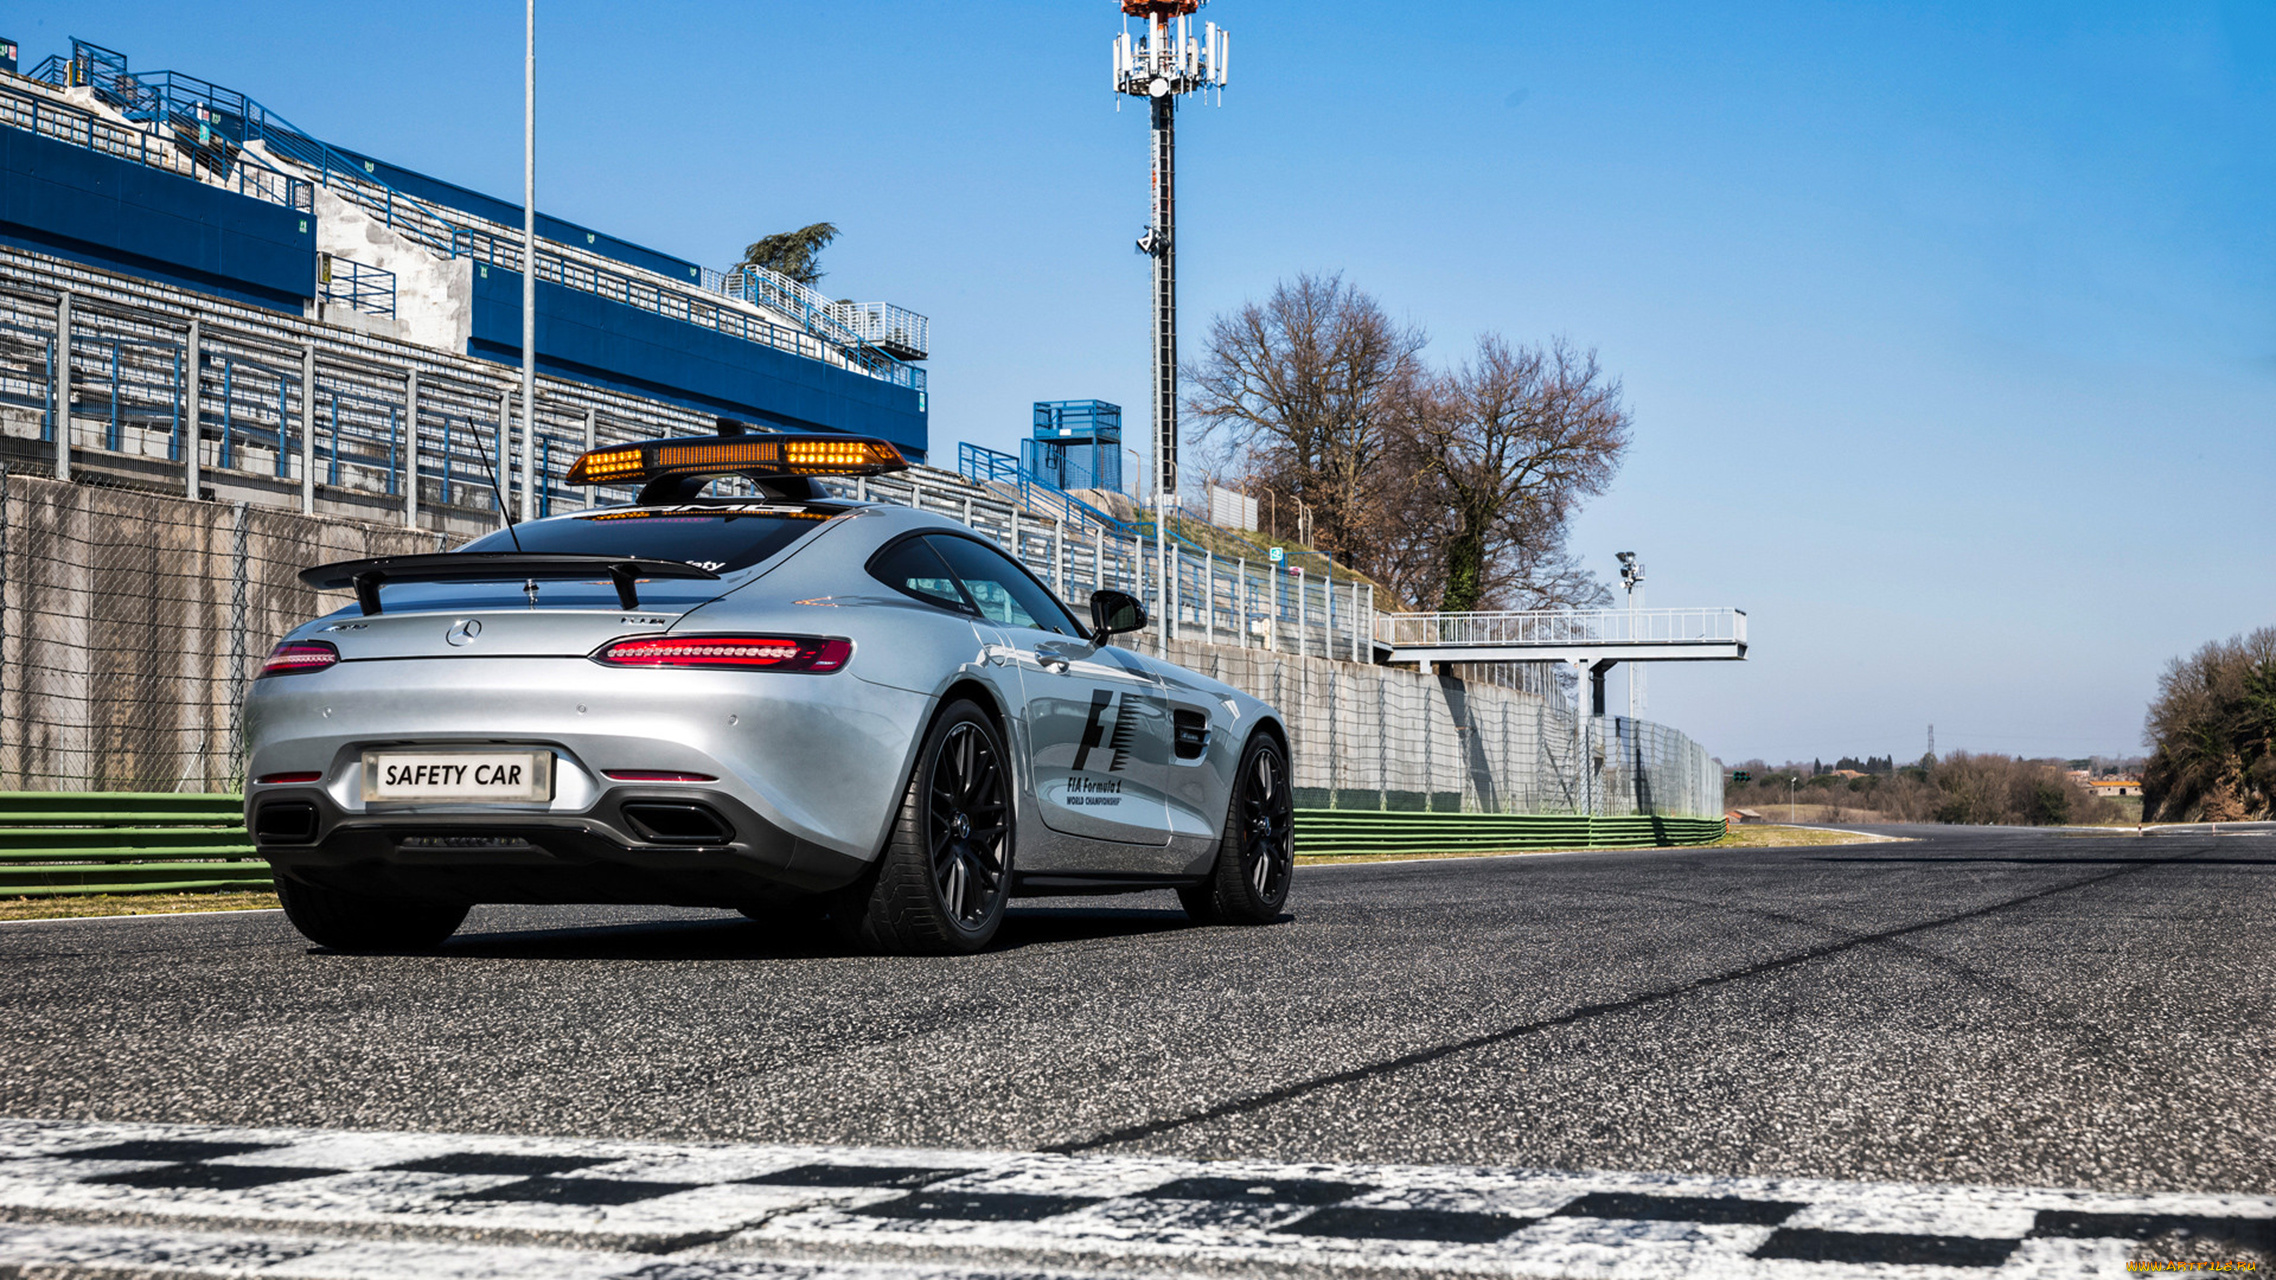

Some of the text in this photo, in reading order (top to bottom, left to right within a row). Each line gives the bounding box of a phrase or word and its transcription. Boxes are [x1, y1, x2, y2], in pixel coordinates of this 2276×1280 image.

[385, 764, 522, 786] SAFETY CAR
[1067, 777, 1122, 793] FIA Formula 1
[1066, 796, 1121, 806] WORLD CHAMPIONSHIP
